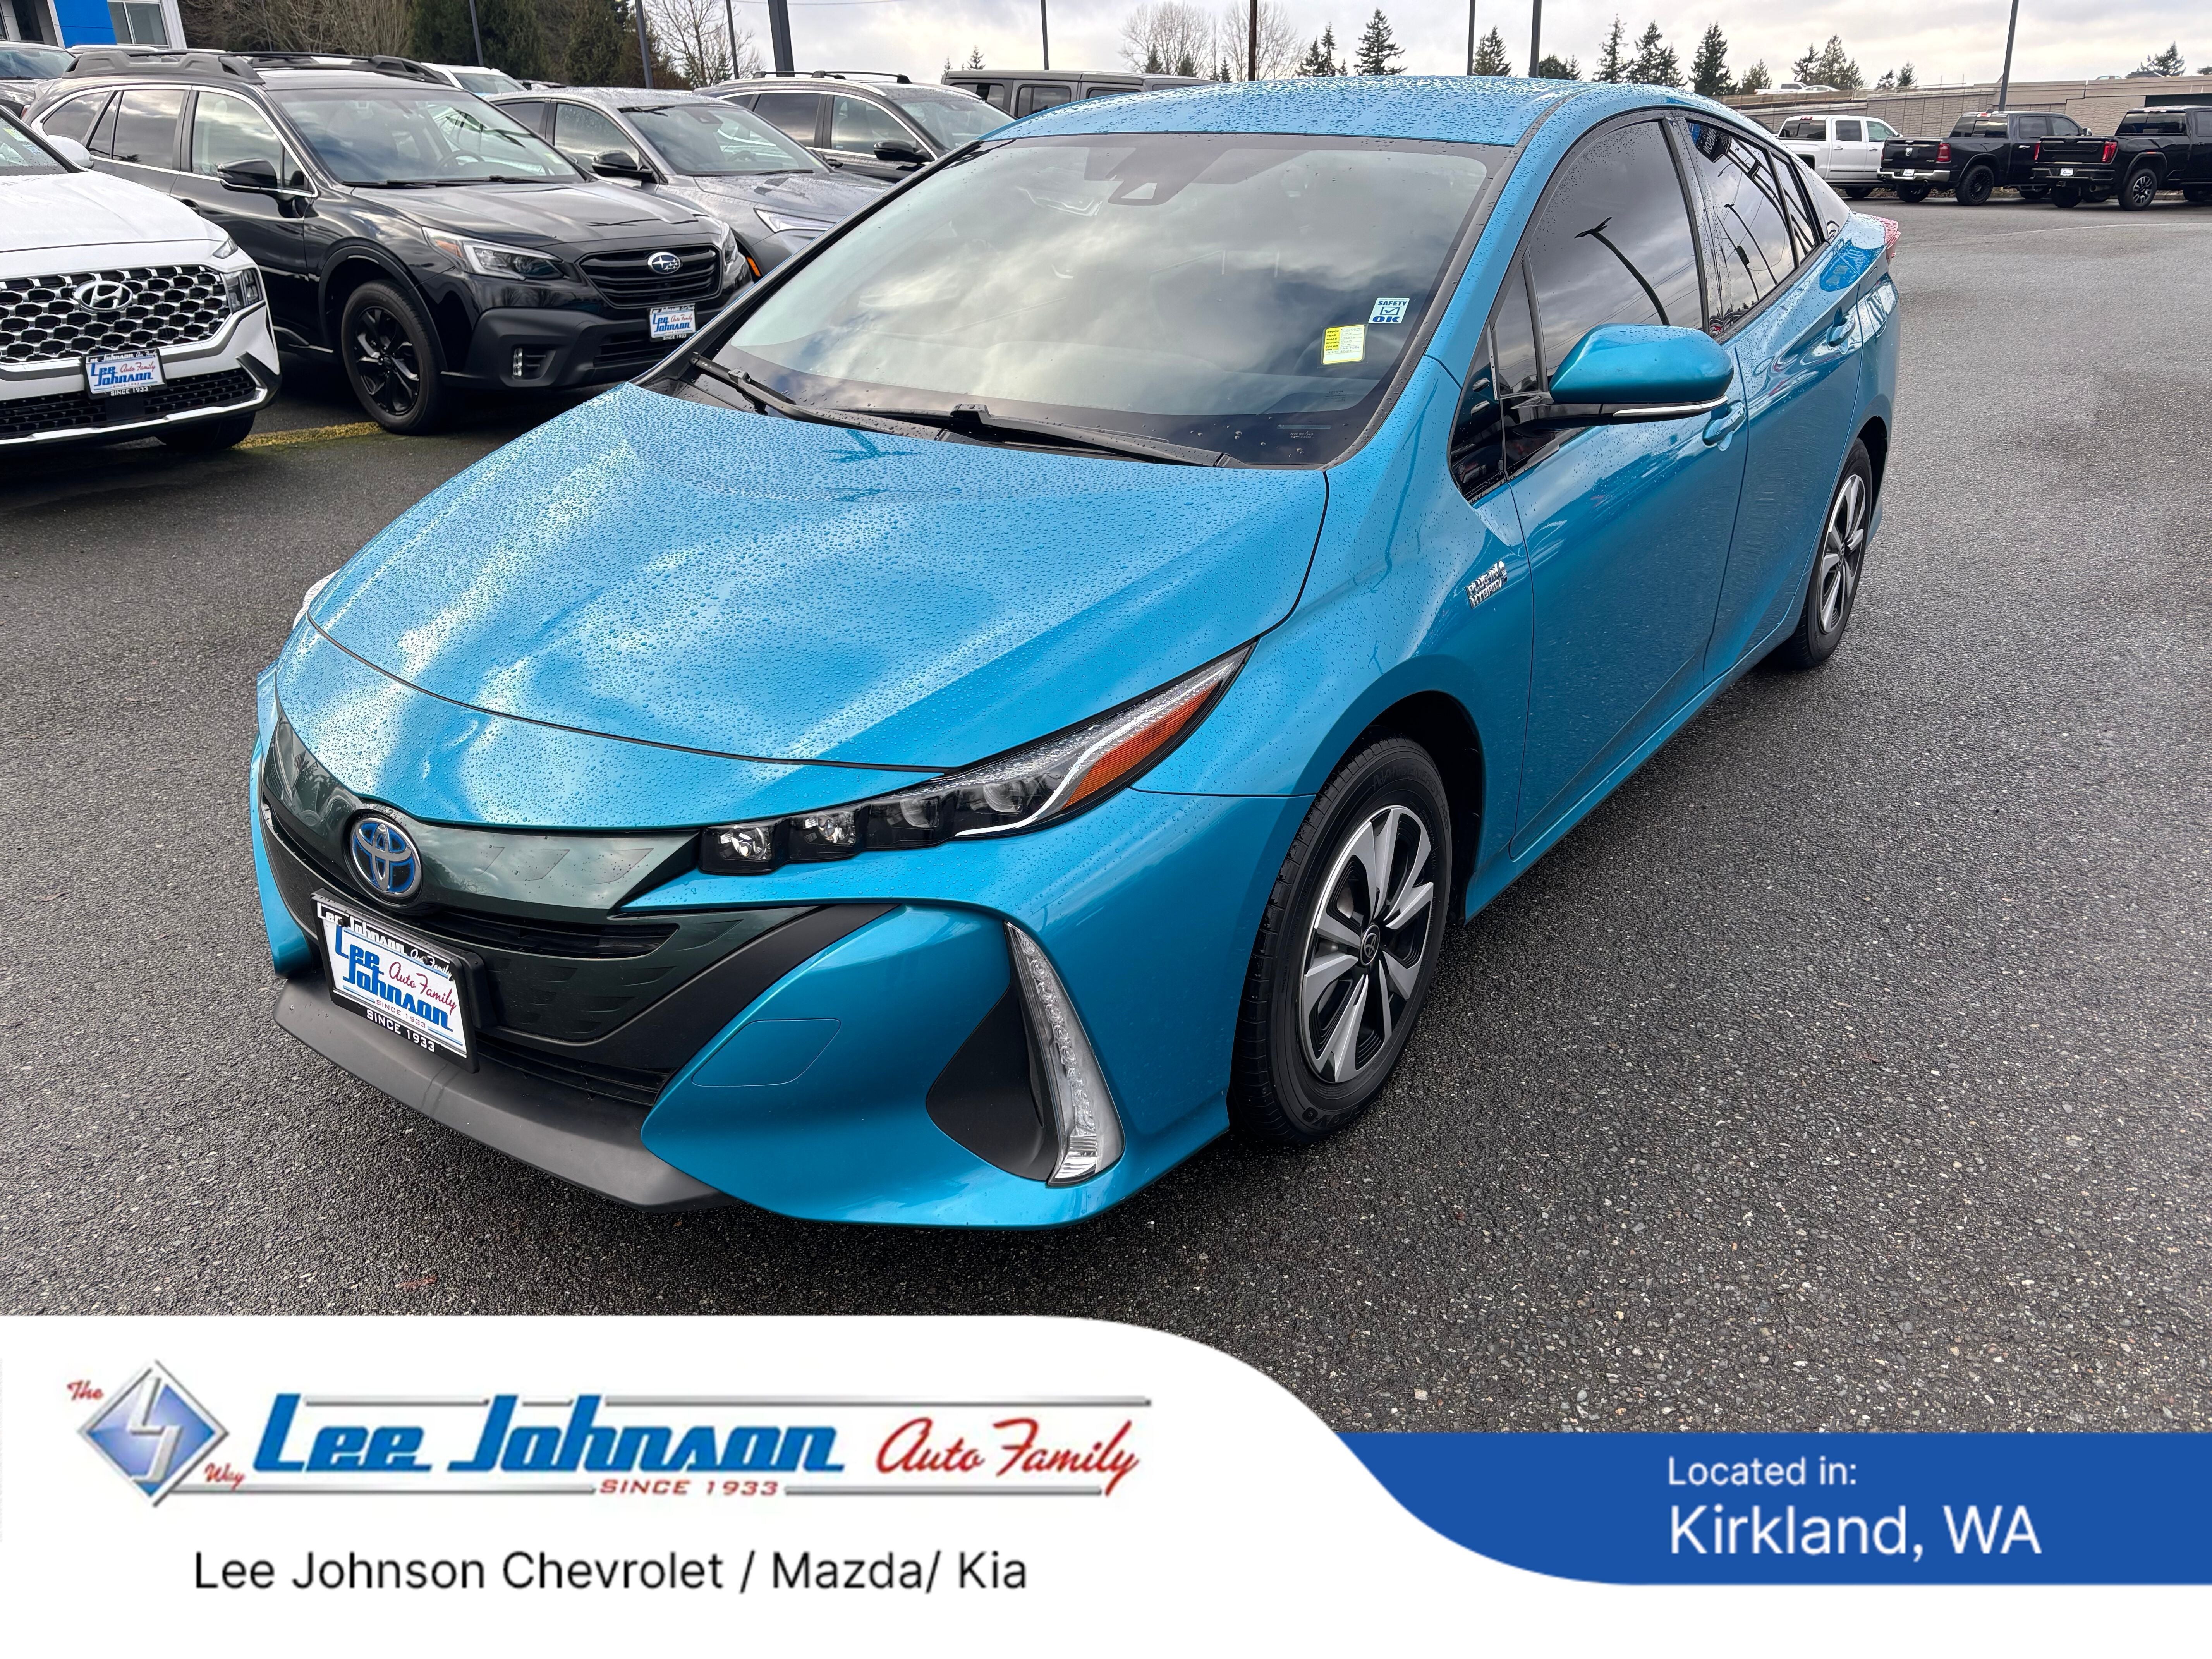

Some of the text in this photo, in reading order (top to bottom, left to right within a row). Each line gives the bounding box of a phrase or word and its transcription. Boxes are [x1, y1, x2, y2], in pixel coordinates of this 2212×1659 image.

[653, 314, 669, 325] Lee
[654, 321, 691, 333] Johnson
[90, 361, 155, 376] Lee Auto Family
[94, 372, 153, 387] Johnson
[347, 915, 407, 956] Johnson
[427, 955, 453, 981] Family
[335, 924, 457, 1015] Lee Auto Family
[343, 962, 453, 1032] Johnson
[376, 999, 426, 1029] SINCE 1933
[367, 1009, 435, 1053] SINCE 1933
